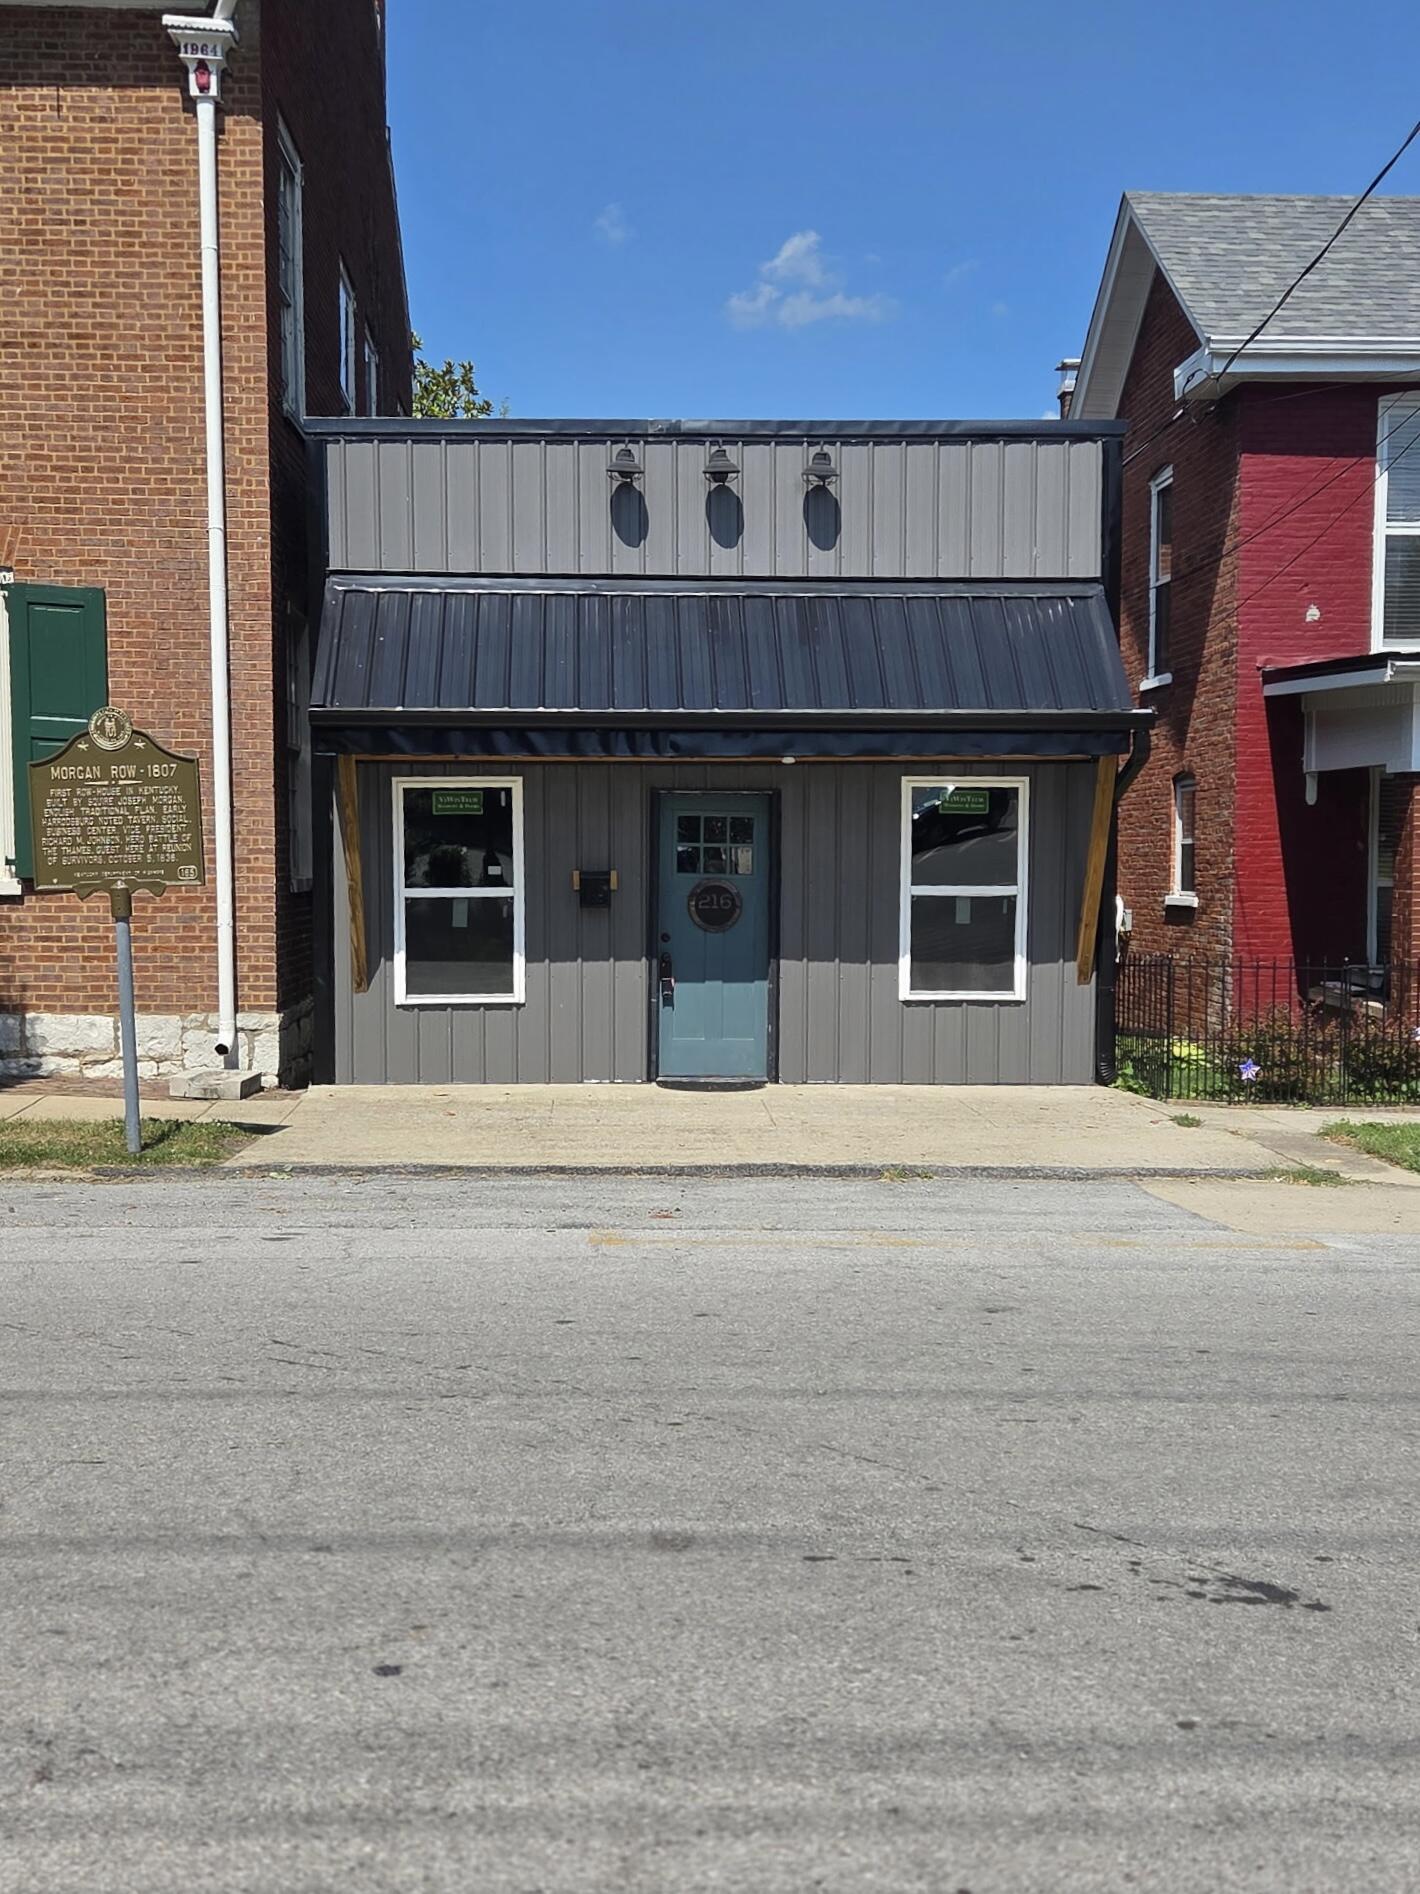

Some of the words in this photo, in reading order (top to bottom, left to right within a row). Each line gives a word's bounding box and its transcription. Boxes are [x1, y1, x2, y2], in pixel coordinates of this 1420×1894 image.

[50, 766, 100, 780] MORGAN
[50, 788, 72, 798] FIRST
[125, 786, 134, 796] IN
[46, 798, 68, 808] BUILT
[73, 797, 82, 806] BY
[118, 796, 146, 805] JOSEPH
[44, 808, 74, 817] ENGLISH
[80, 806, 130, 816] TRADITIONAL
[162, 804, 186, 814] EARLY
[98, 816, 123, 825] NOTED
[123, 825, 141, 834] VICE
[146, 824, 187, 834] PRESIDENT
[42, 836, 72, 846] RICHARD
[126, 834, 145, 844] HERO
[148, 834, 178, 843] BATTLE
[182, 834, 192, 842] OF
[42, 846, 58, 856] THE
[96, 846, 120, 854] GUEST
[126, 844, 145, 854] HERE
[149, 844, 158, 852] AT
[162, 844, 192, 852] REUNION
[48, 856, 58, 865] OF
[108, 854, 142, 864] OCTOBER
[698, 894, 732, 908] 216
